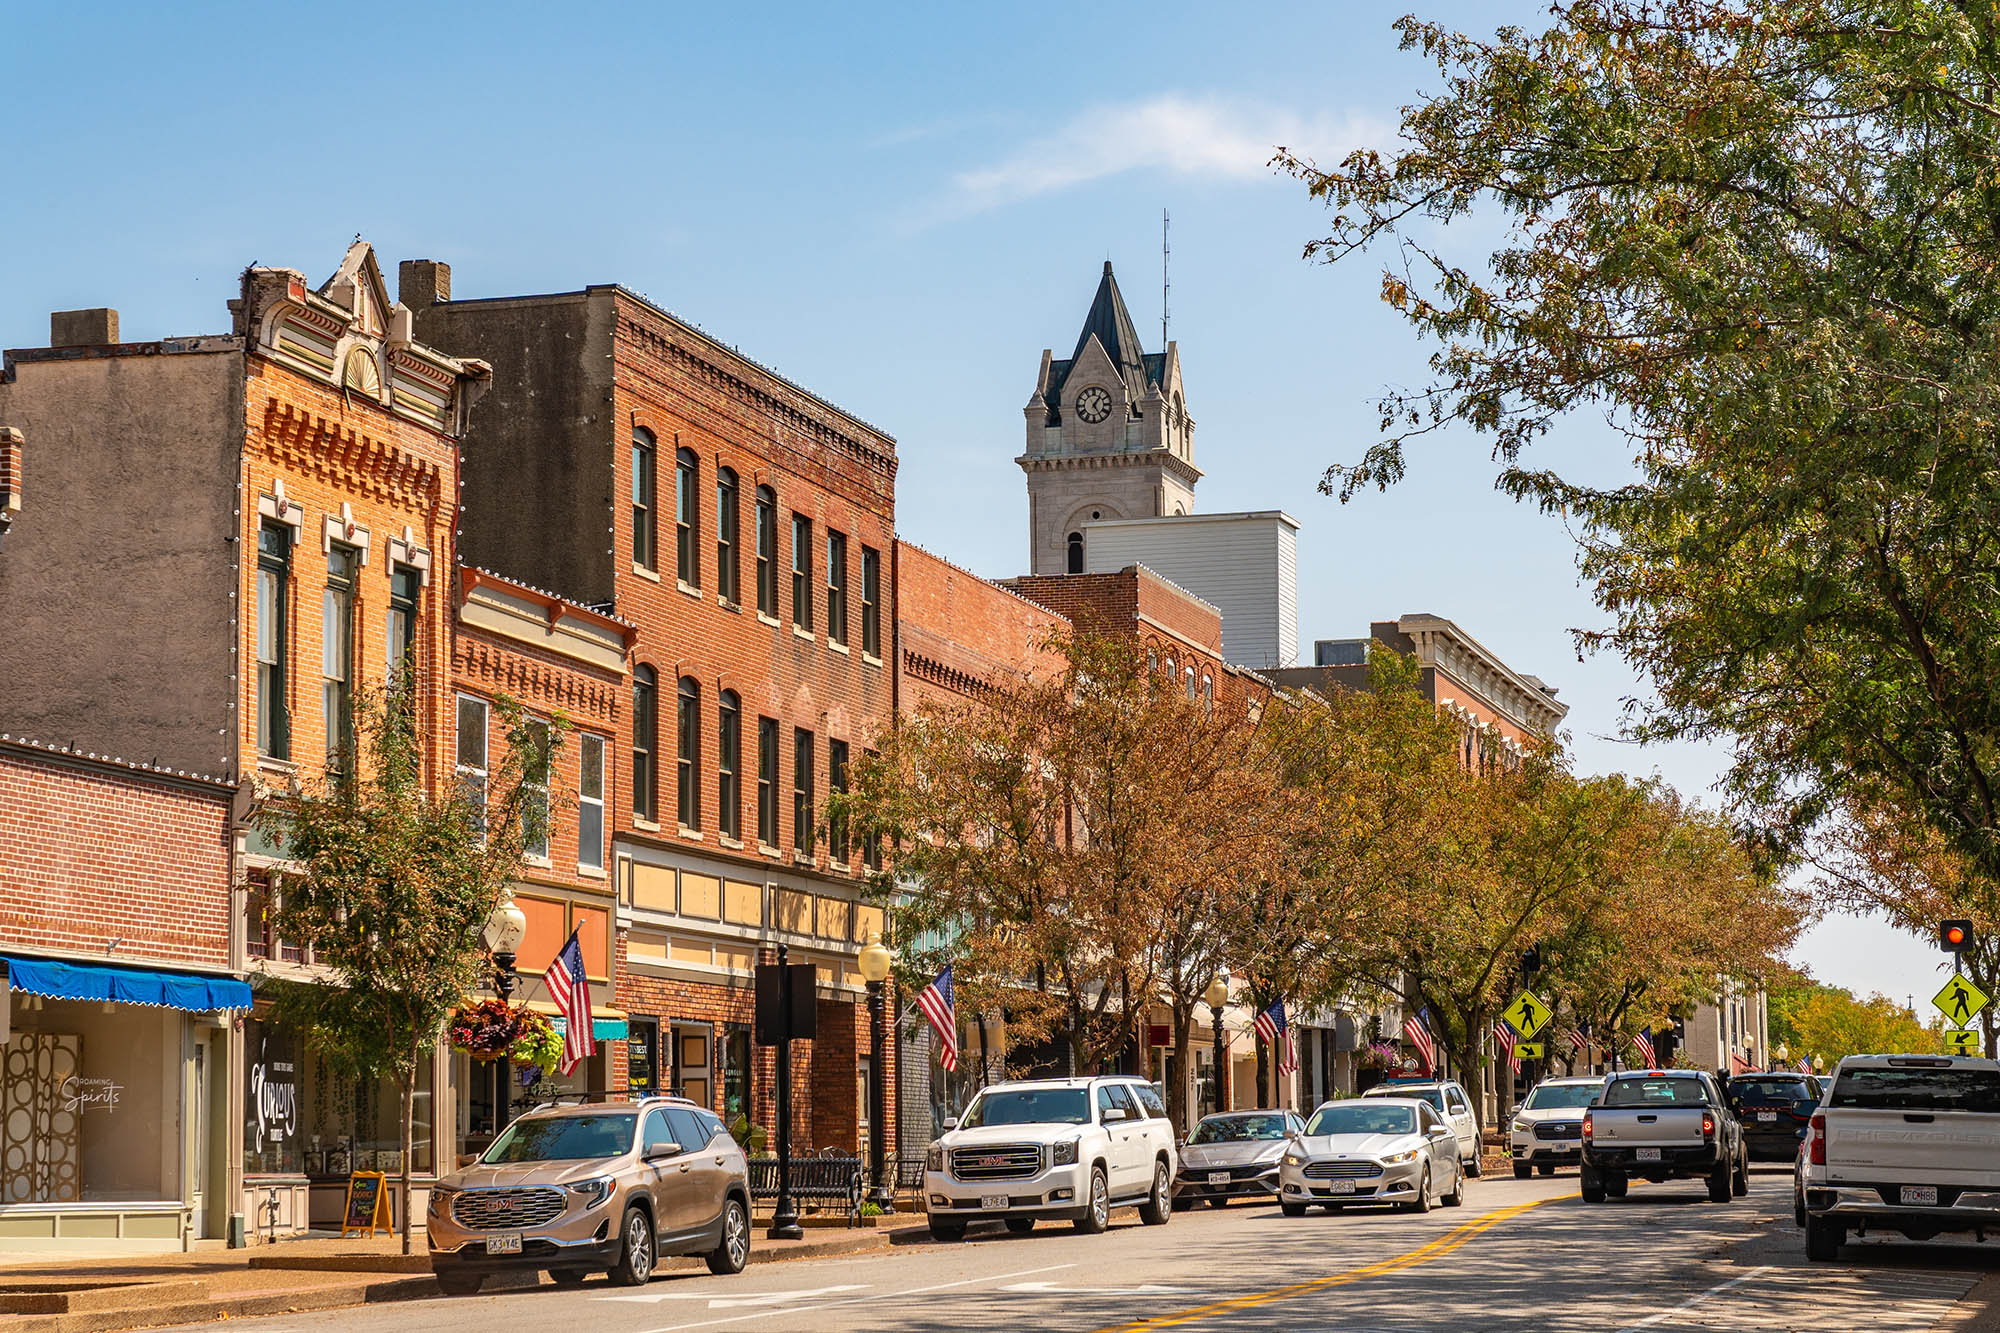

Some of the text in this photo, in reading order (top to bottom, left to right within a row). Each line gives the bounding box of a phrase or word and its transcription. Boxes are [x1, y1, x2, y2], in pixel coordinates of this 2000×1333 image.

[62, 1076, 124, 1115] Spirits
[252, 1062, 296, 1154] CURIOUS
[979, 1157, 1012, 1166] GMC
[486, 1200, 521, 1209] GMC
